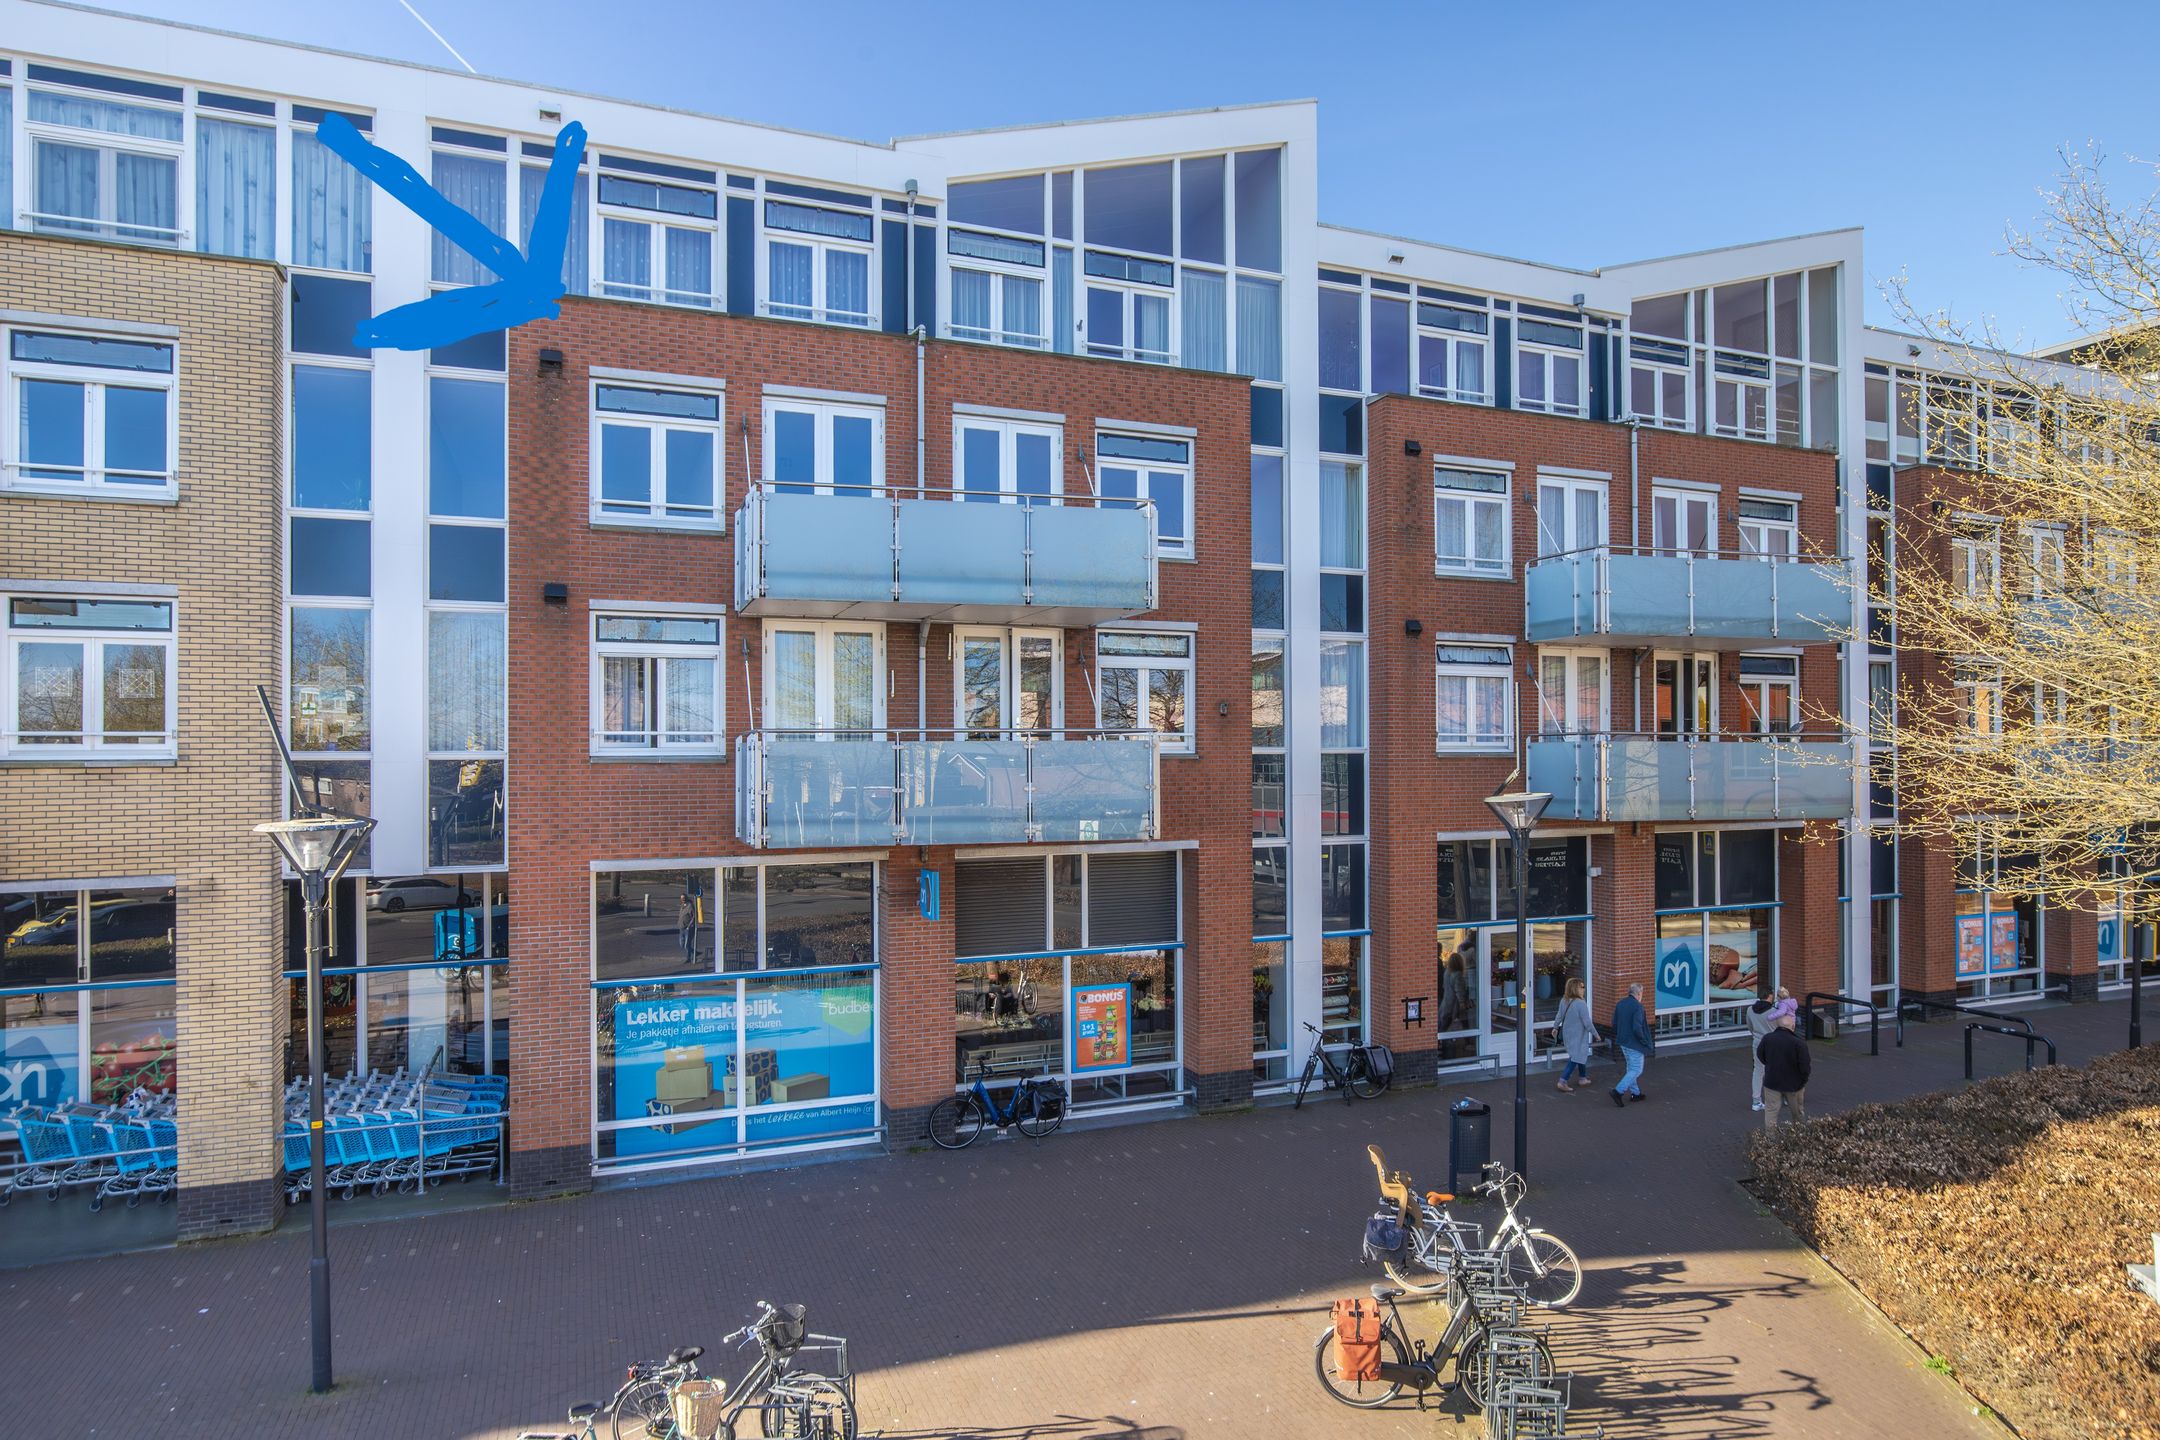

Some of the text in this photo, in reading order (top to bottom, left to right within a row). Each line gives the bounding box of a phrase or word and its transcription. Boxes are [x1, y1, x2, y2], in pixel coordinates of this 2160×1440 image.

[1087, 991, 1124, 1004] BONUS
[626, 1006, 690, 1025] Lekker
[626, 1030, 638, 1040] Je
[640, 1026, 680, 1040] pakketje
[681, 1023, 716, 1036] afhalen
[717, 1023, 730, 1032] en
[1082, 1023, 1096, 1031] 1+1
[753, 1116, 767, 1125] het
[805, 1111, 820, 1119] van
[820, 1108, 843, 1117] Albert
[843, 1105, 862, 1115] Heijn
